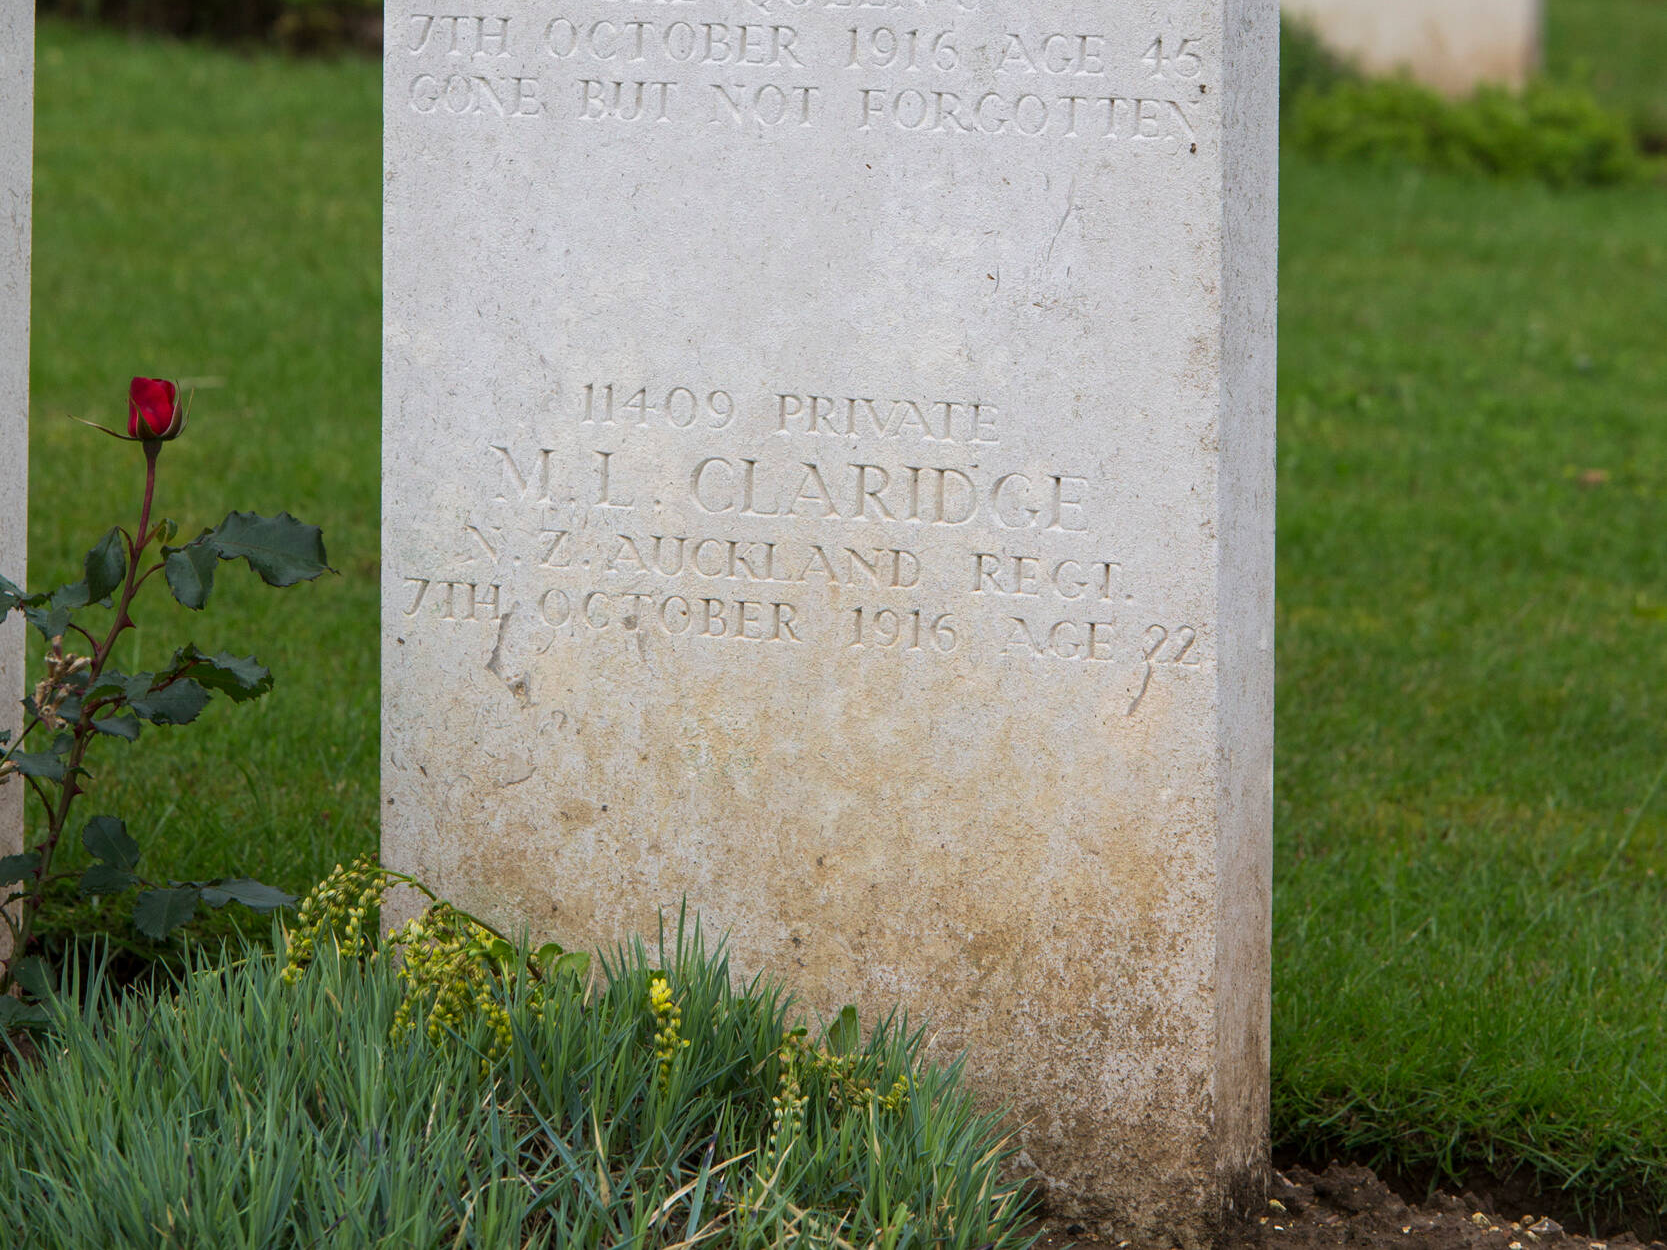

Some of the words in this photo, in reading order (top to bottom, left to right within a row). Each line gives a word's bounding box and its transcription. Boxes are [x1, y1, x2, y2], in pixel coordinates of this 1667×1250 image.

[408, 14, 514, 60] 7TH
[545, 18, 806, 70] OCTOBER
[846, 26, 961, 74] 1916
[997, 32, 1104, 78] AGE
[1139, 33, 1203, 80] 45
[408, 74, 540, 118] GONE
[579, 78, 678, 124] BUT
[708, 82, 820, 130] NOT
[858, 87, 1203, 144] FORGOTTEN
[580, 382, 736, 428] 11409
[776, 394, 1000, 445] PRIVATE
[689, 454, 1090, 533] CLARIDGE
[971, 553, 1135, 603] REGT.
[403, 577, 503, 626] 7TH
[538, 586, 803, 643] OCTOBER
[850, 607, 958, 654] 1916
[998, 617, 1118, 665] AGE
[1141, 622, 1203, 669] 22
